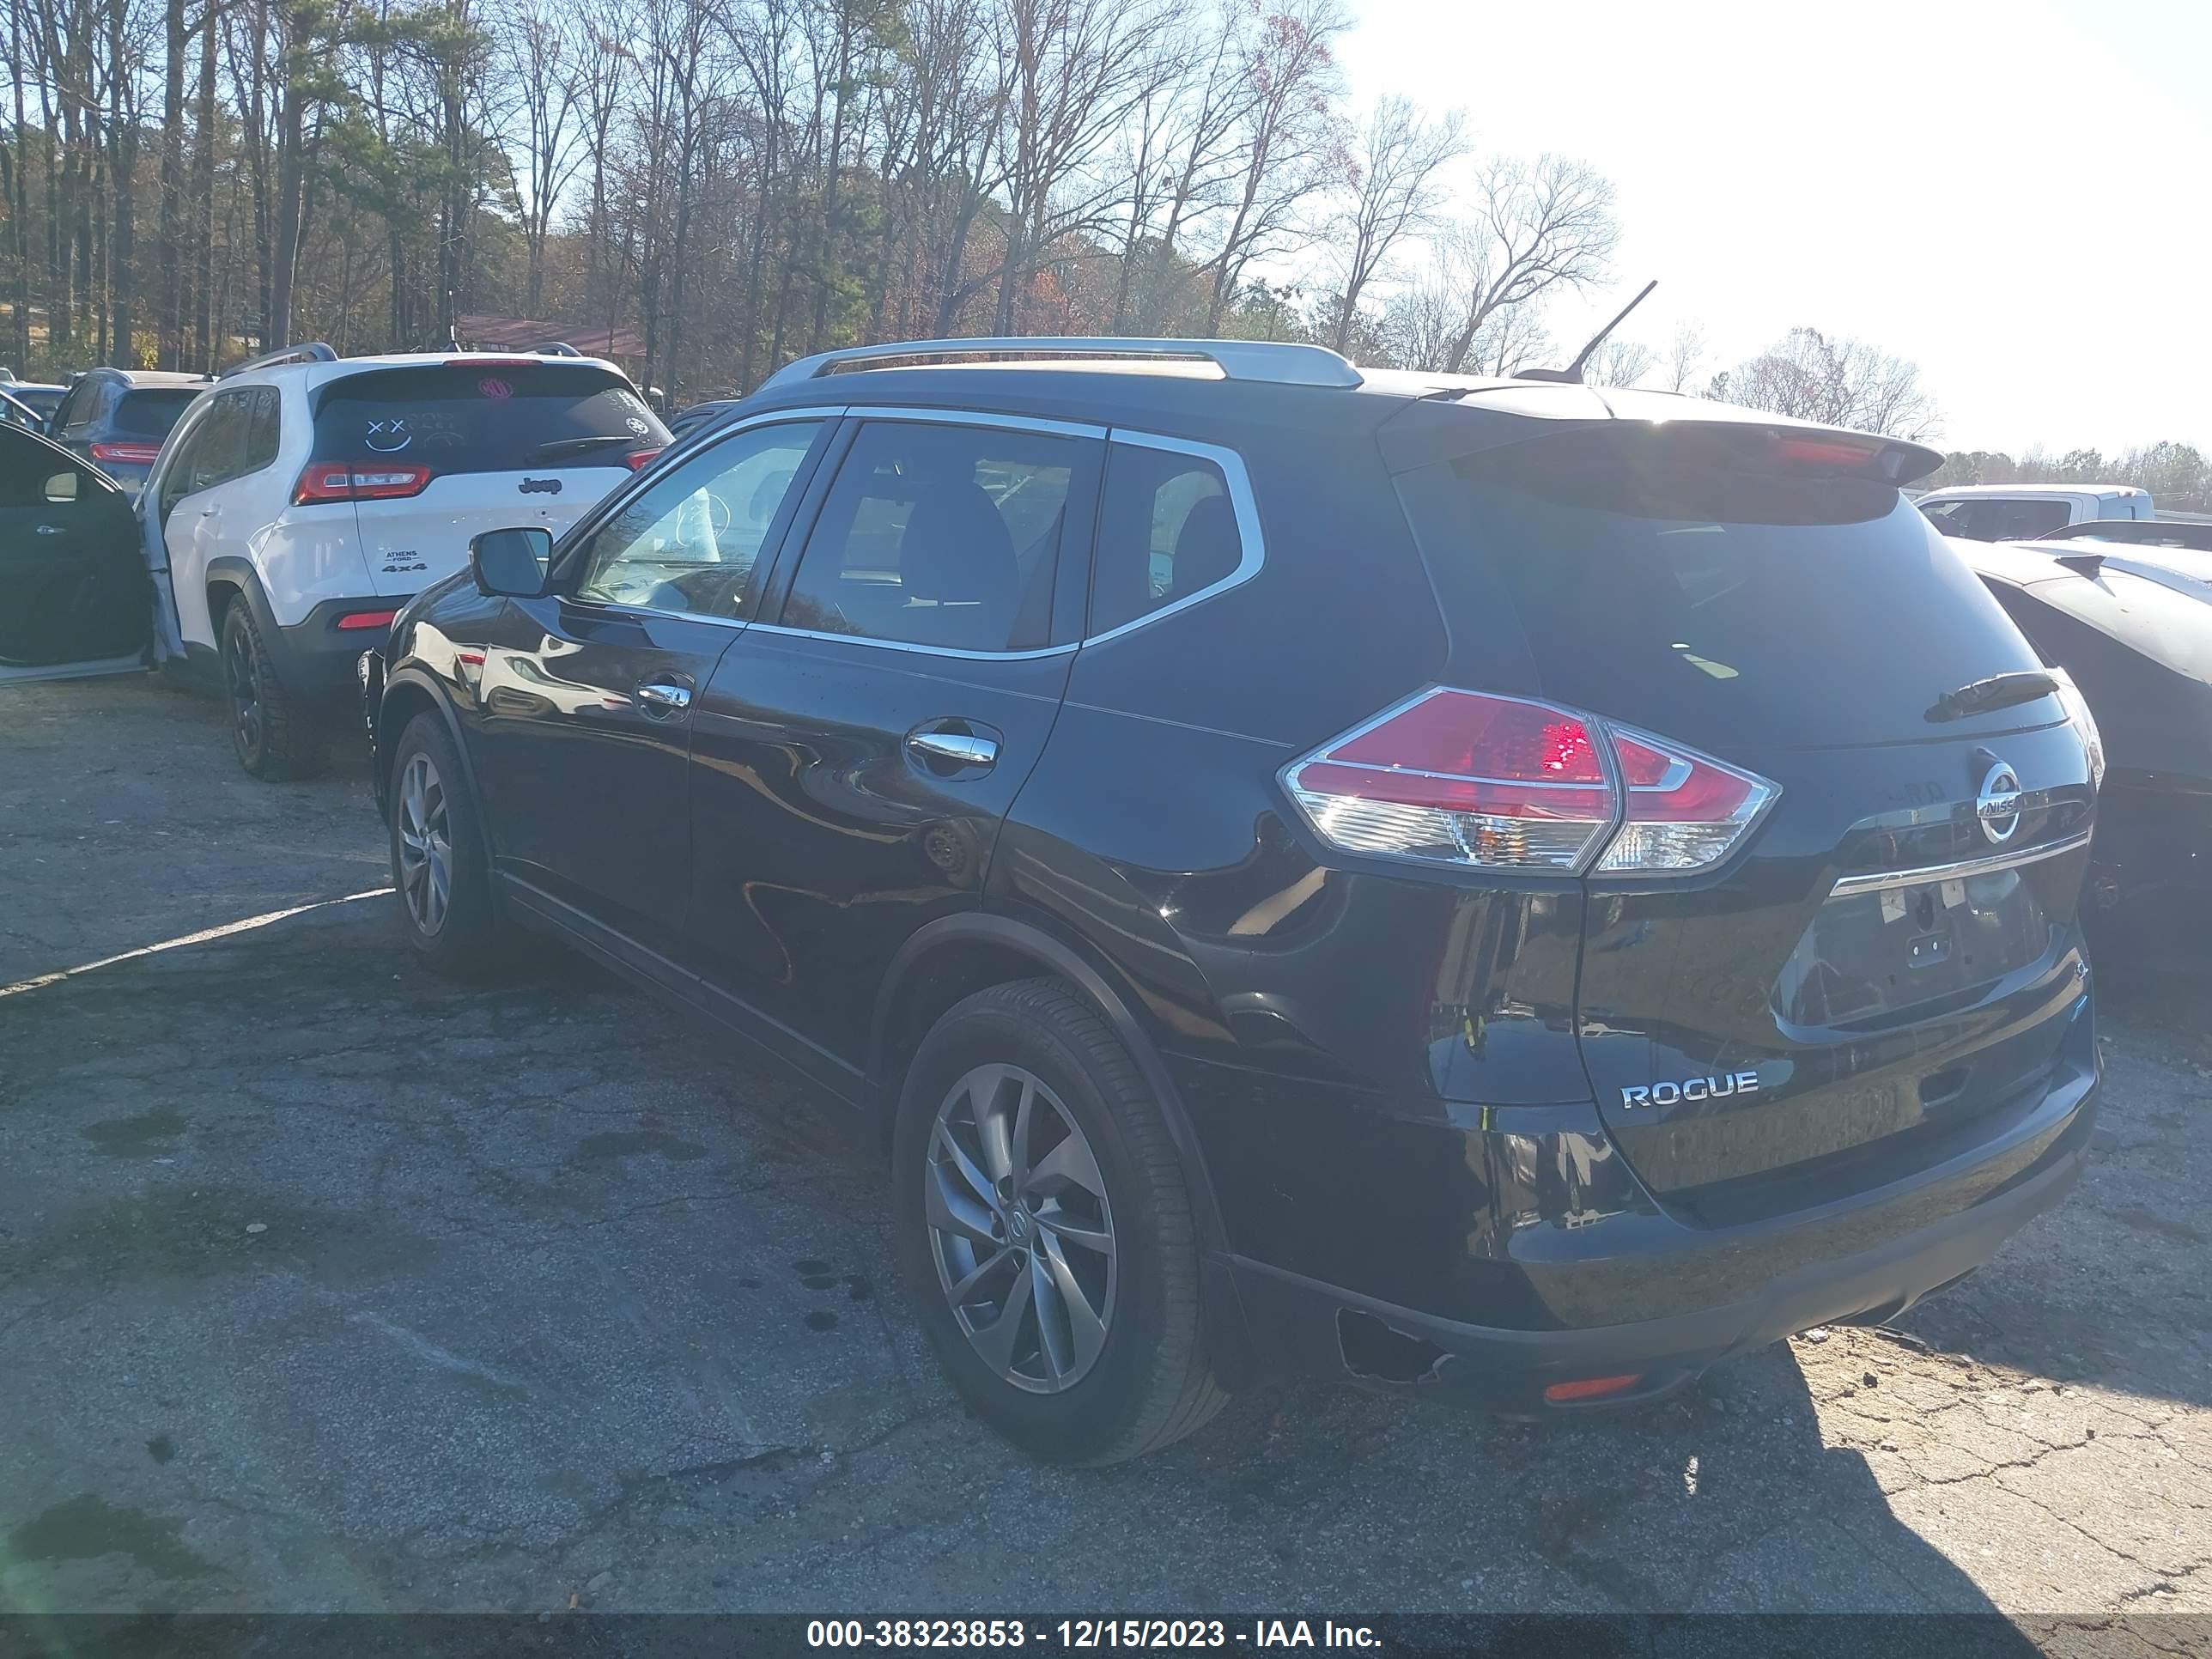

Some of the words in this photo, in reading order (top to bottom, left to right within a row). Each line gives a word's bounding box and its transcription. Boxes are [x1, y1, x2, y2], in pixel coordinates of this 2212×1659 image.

[518, 477, 562, 495] Jeep
[381, 563, 428, 573] 4x4
[1986, 795, 2020, 814] NISS
[1620, 1071, 1759, 1109] ROGUE
